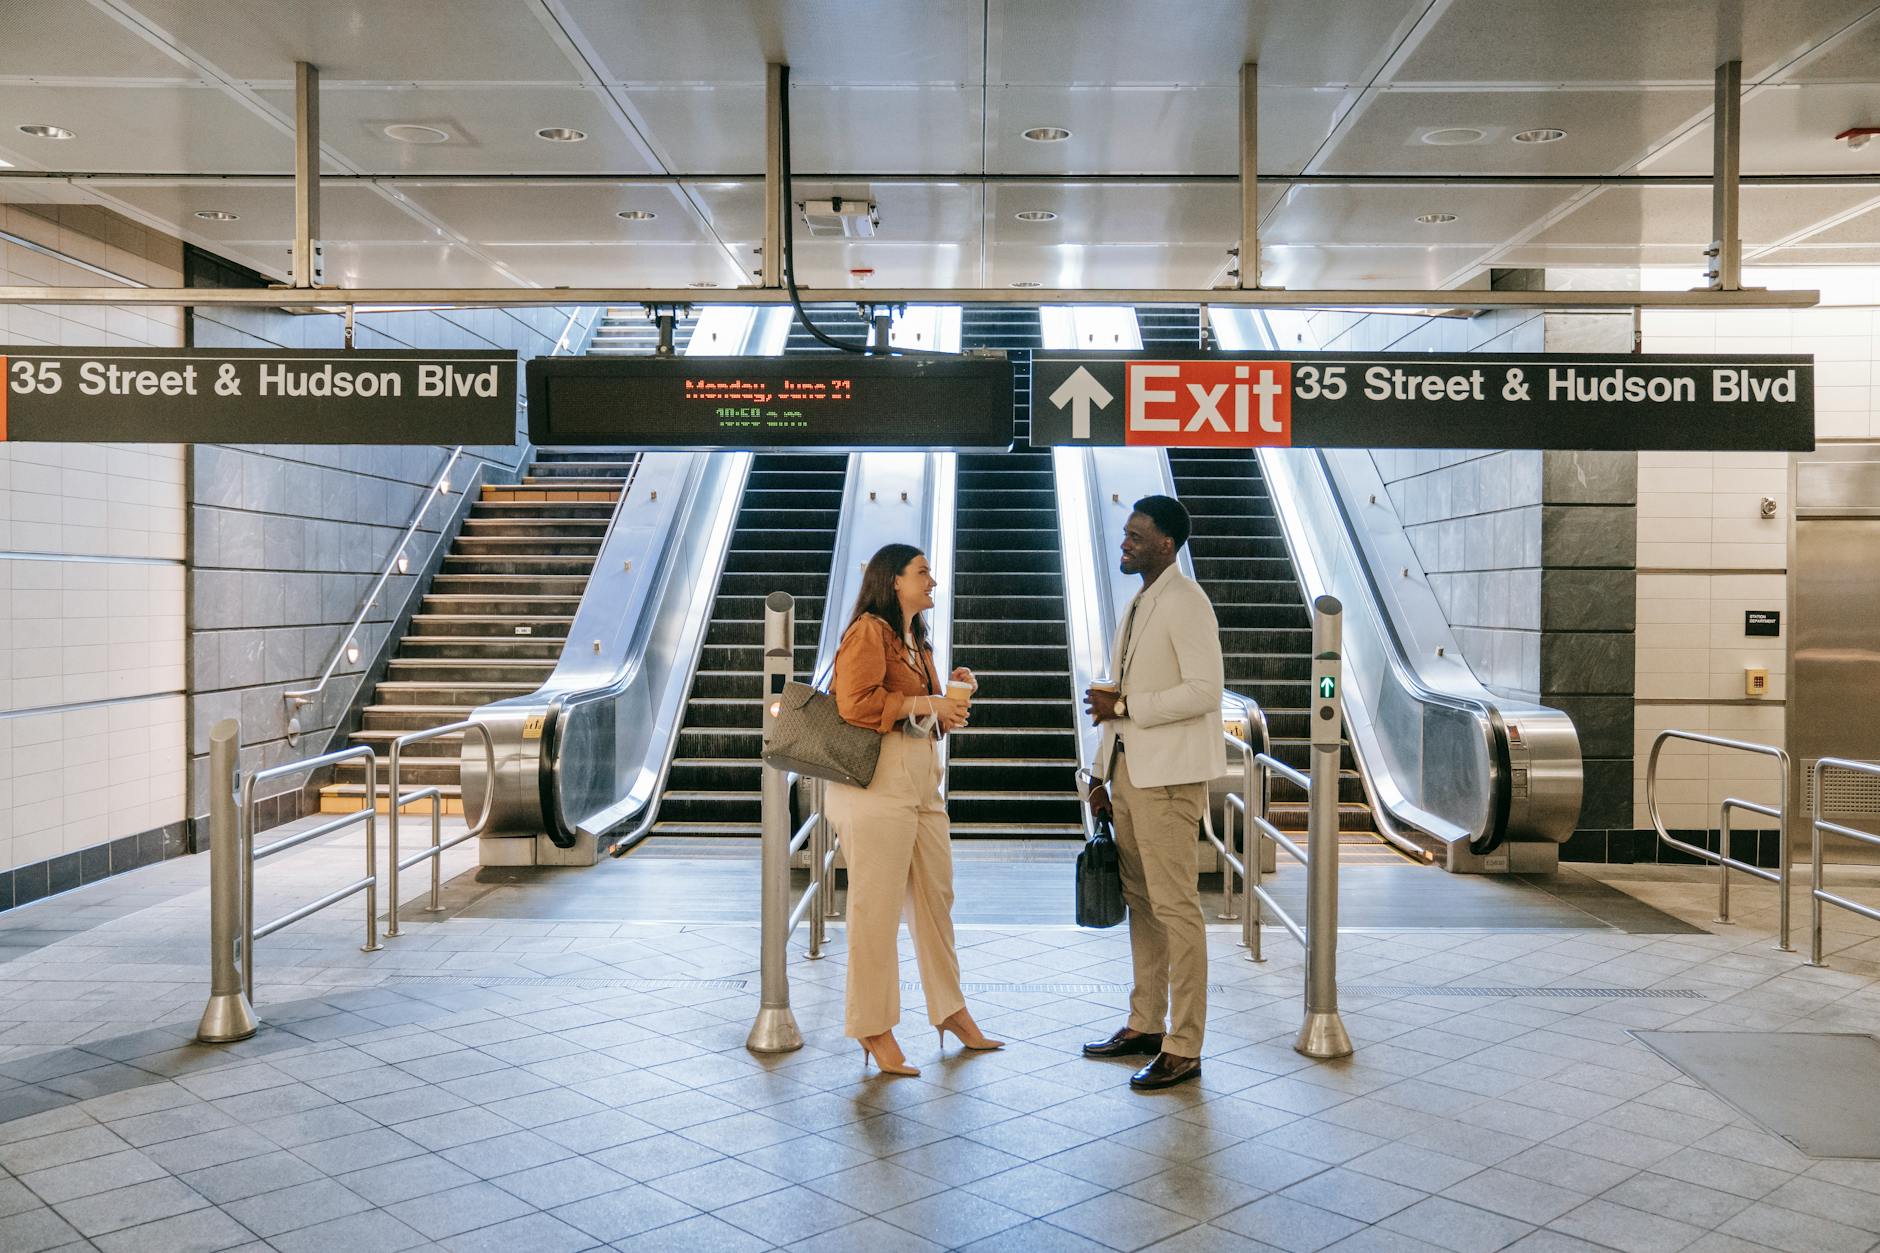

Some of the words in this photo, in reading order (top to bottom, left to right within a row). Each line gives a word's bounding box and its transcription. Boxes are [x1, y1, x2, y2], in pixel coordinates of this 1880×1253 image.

[11, 361, 62, 394] 35
[79, 362, 197, 395] Street
[215, 364, 242, 396] &
[260, 364, 402, 397] Hudson
[419, 365, 497, 397] Blvd
[685, 380, 773, 402] Monday,
[778, 380, 826, 399] June
[1295, 366, 1347, 399] 35
[1364, 367, 1484, 400] Street
[1502, 368, 1530, 401] &
[1549, 369, 1695, 402] Hudson
[1713, 370, 1796, 402] Blvd
[1131, 365, 1282, 432] Exit
